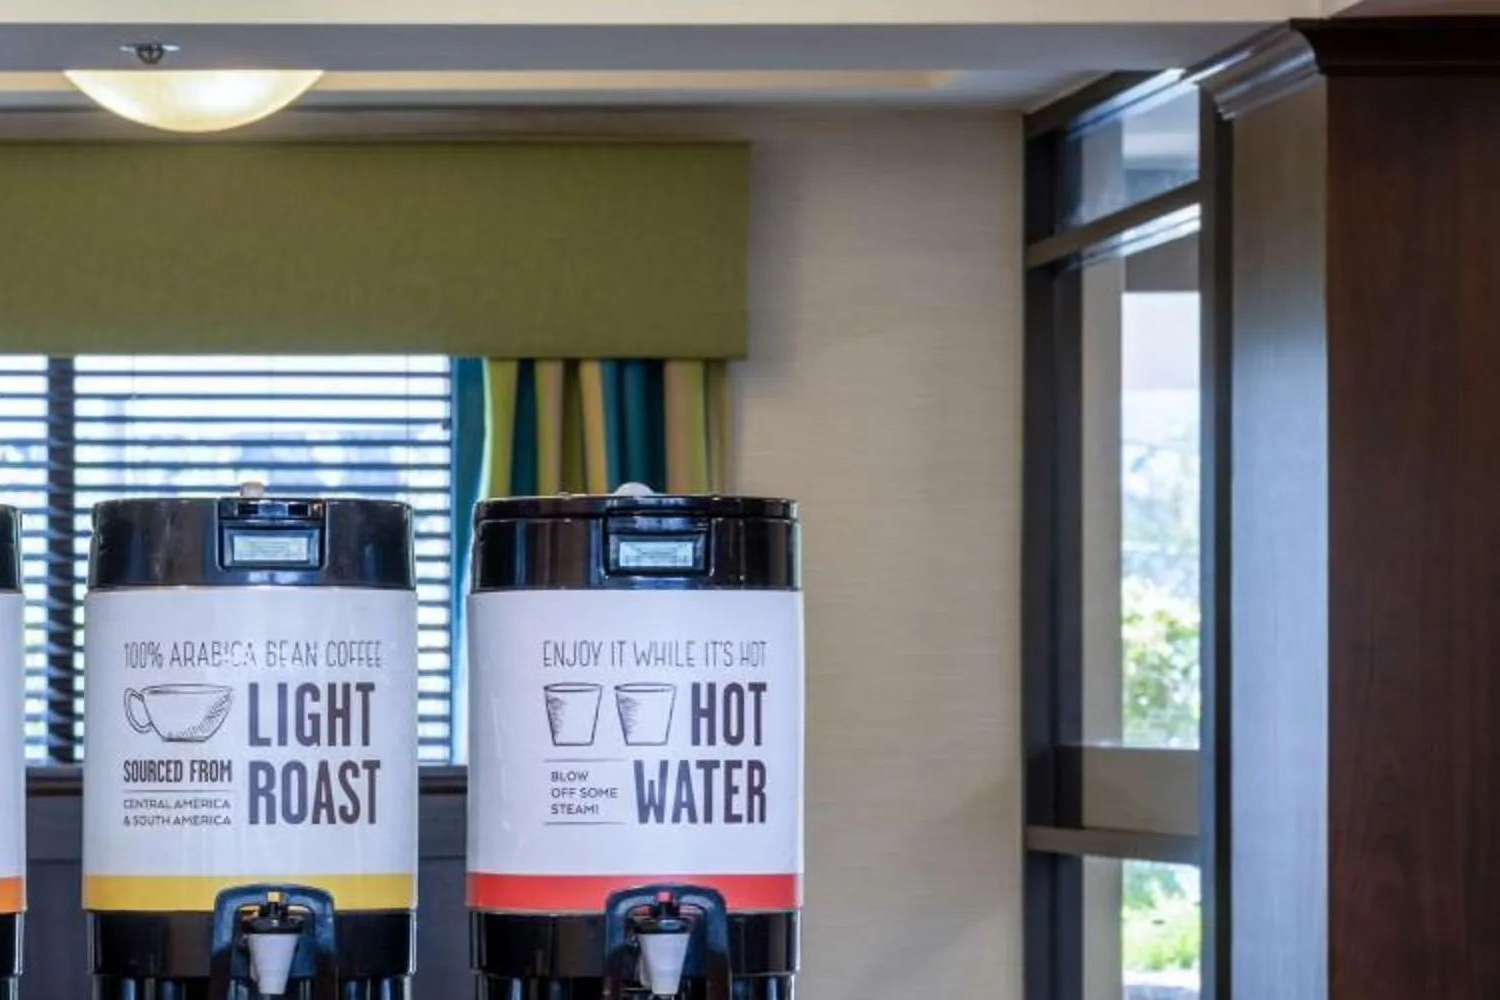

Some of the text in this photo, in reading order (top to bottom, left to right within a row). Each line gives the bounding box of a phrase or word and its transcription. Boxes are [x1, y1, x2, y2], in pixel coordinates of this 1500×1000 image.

[124, 640, 164, 669] 100%
[325, 639, 382, 668] COFFEE
[543, 640, 768, 668] ENJOY IT WHILE IT'S HOT
[248, 682, 376, 748] LIGHT
[691, 681, 768, 747] HOT
[123, 759, 233, 785] SOURCED FROM
[551, 771, 589, 782] BLOW
[123, 799, 231, 809] CENTRAL AMERICA
[248, 759, 381, 826] ROAST
[551, 787, 619, 798] OFF SOME
[633, 759, 767, 825] WATER
[133, 815, 171, 826] SOUTH
[172, 815, 232, 826] AMERICA
